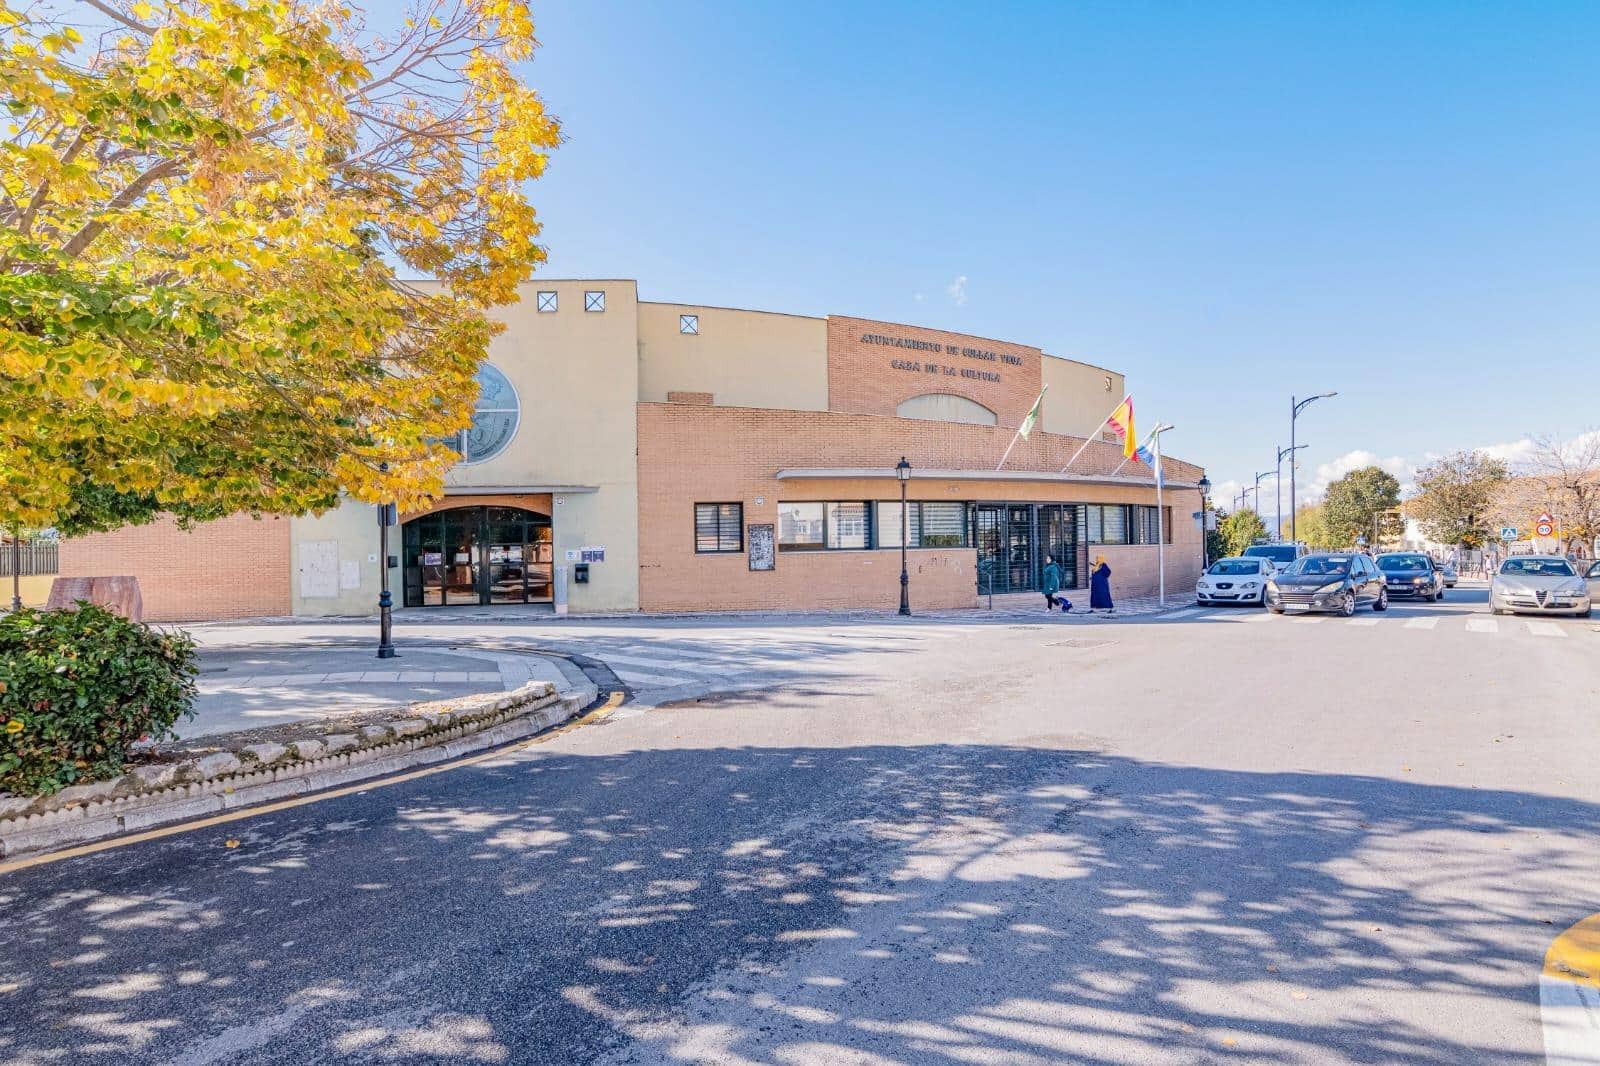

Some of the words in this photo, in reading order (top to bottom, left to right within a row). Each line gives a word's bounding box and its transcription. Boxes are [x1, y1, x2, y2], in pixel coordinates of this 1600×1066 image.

[861, 334, 941, 352] AYUNTAMIENTO
[946, 345, 960, 355] DE
[891, 359, 921, 372] CASA
[925, 363, 938, 374] DE
[943, 365, 957, 377] LA
[961, 368, 1001, 383] CULTURA
